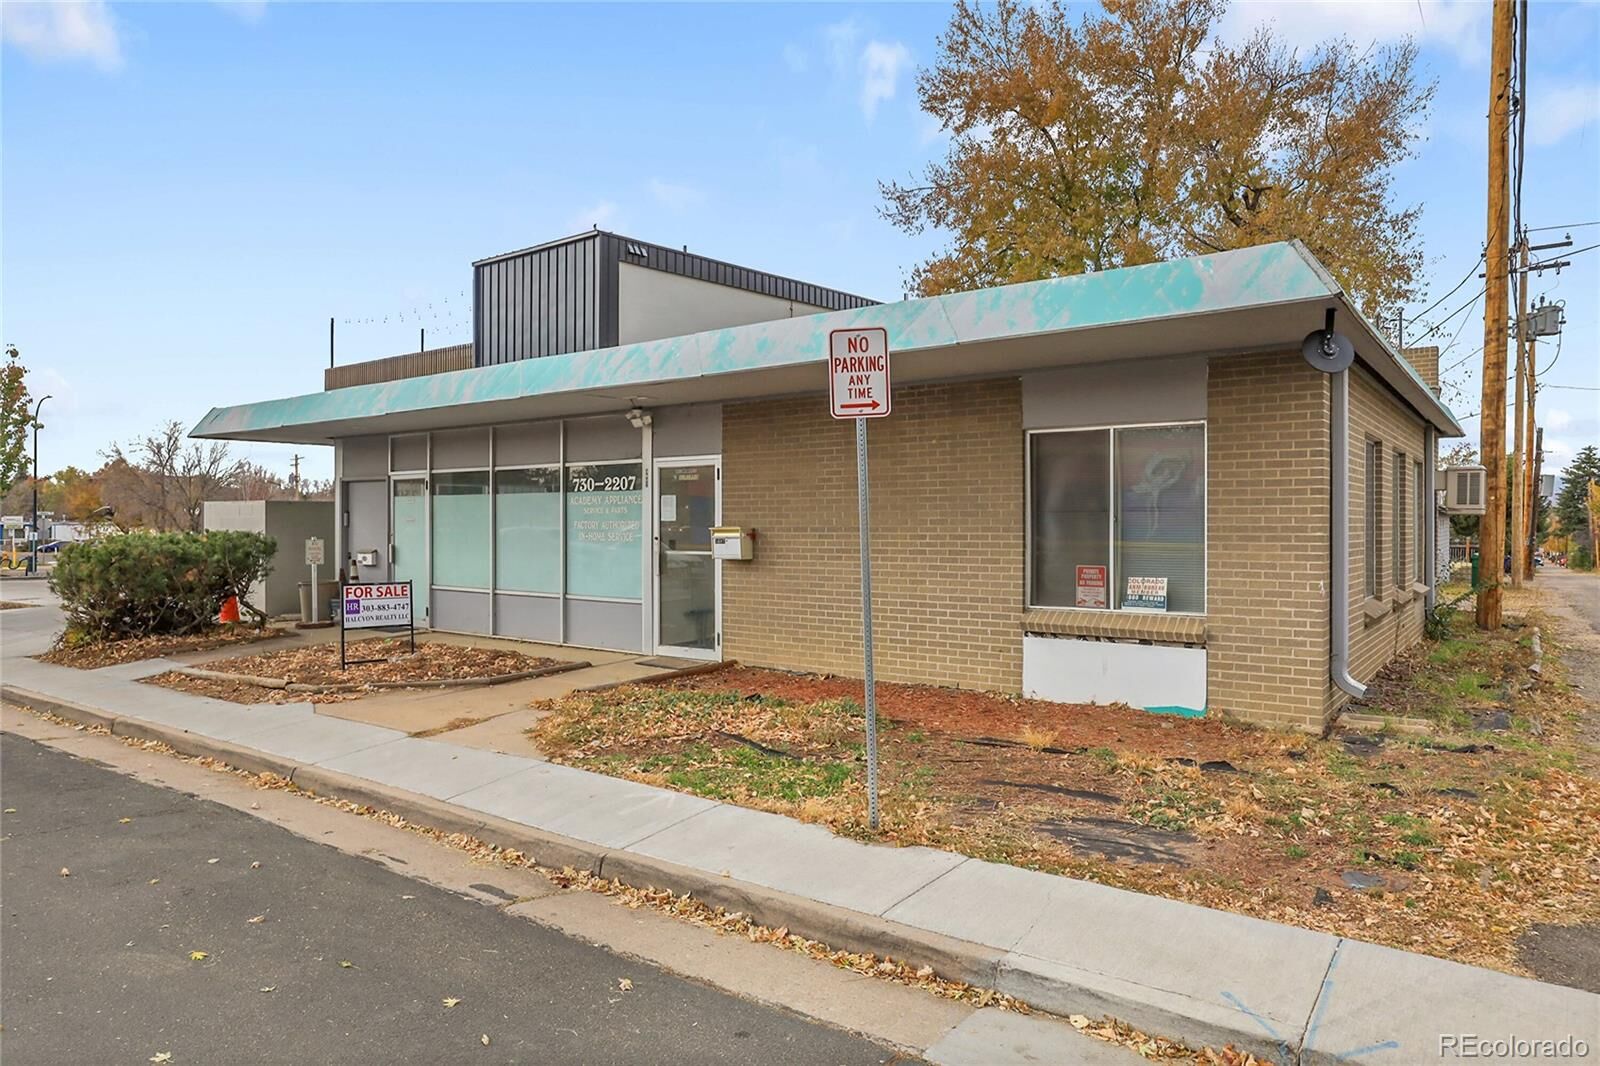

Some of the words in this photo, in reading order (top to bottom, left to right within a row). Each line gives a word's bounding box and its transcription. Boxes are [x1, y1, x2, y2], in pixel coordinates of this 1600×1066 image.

[848, 337, 869, 353] NO
[834, 355, 885, 373] PARKING
[848, 374, 871, 386] ANY
[848, 387, 873, 399] TIME
[572, 476, 637, 492] 730-2207
[570, 496, 603, 505] ACADEMY
[605, 494, 643, 504] APPLIANCE
[583, 506, 603, 514] SERVICE
[574, 520, 599, 530] FACTORY
[602, 520, 640, 529] AUTHORIZED
[607, 532, 634, 541] SERVICE
[345, 586, 373, 599] FOR
[376, 585, 408, 597] SALE
[346, 602, 359, 611] HR
[361, 603, 409, 613] 303-883-4747
[345, 614, 374, 623] HALCYON
[376, 613, 397, 621] REALTY
